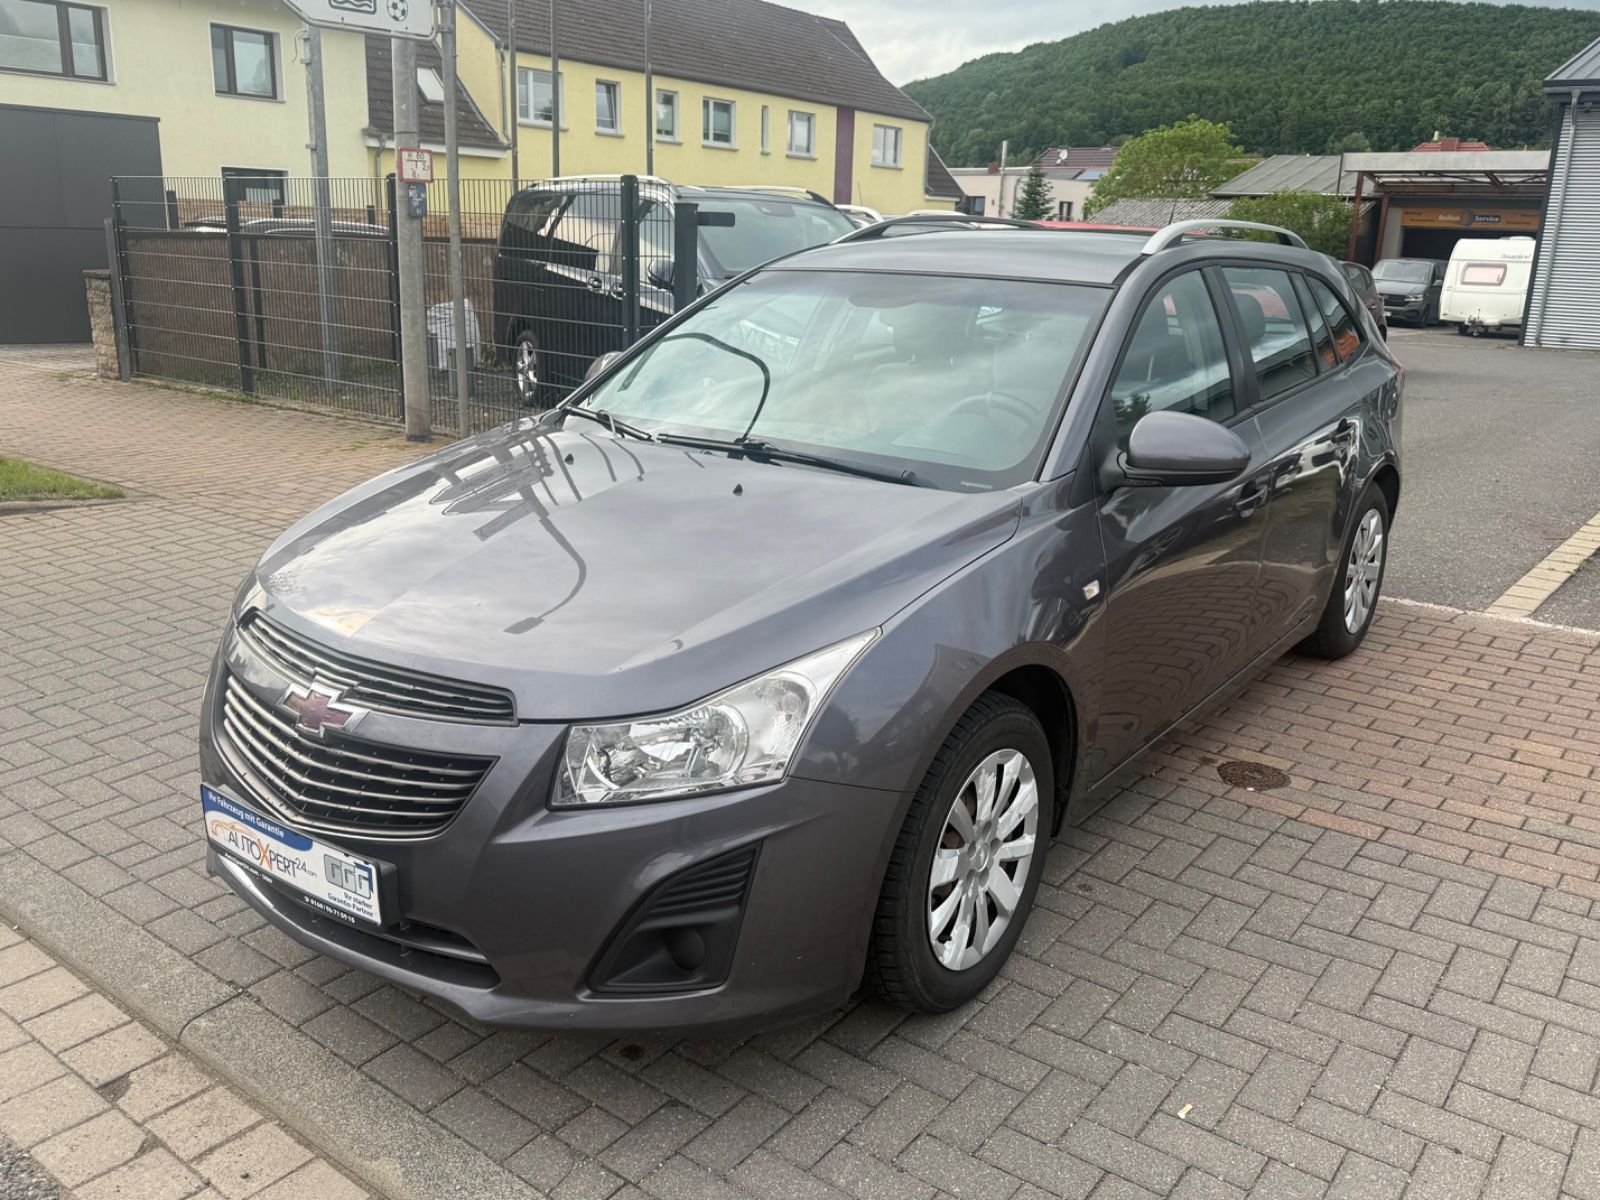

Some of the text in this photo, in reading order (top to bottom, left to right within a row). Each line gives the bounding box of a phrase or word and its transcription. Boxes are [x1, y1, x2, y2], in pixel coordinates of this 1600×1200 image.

[208, 791, 285, 838] Ihr Fahrzeug mit Garantie
